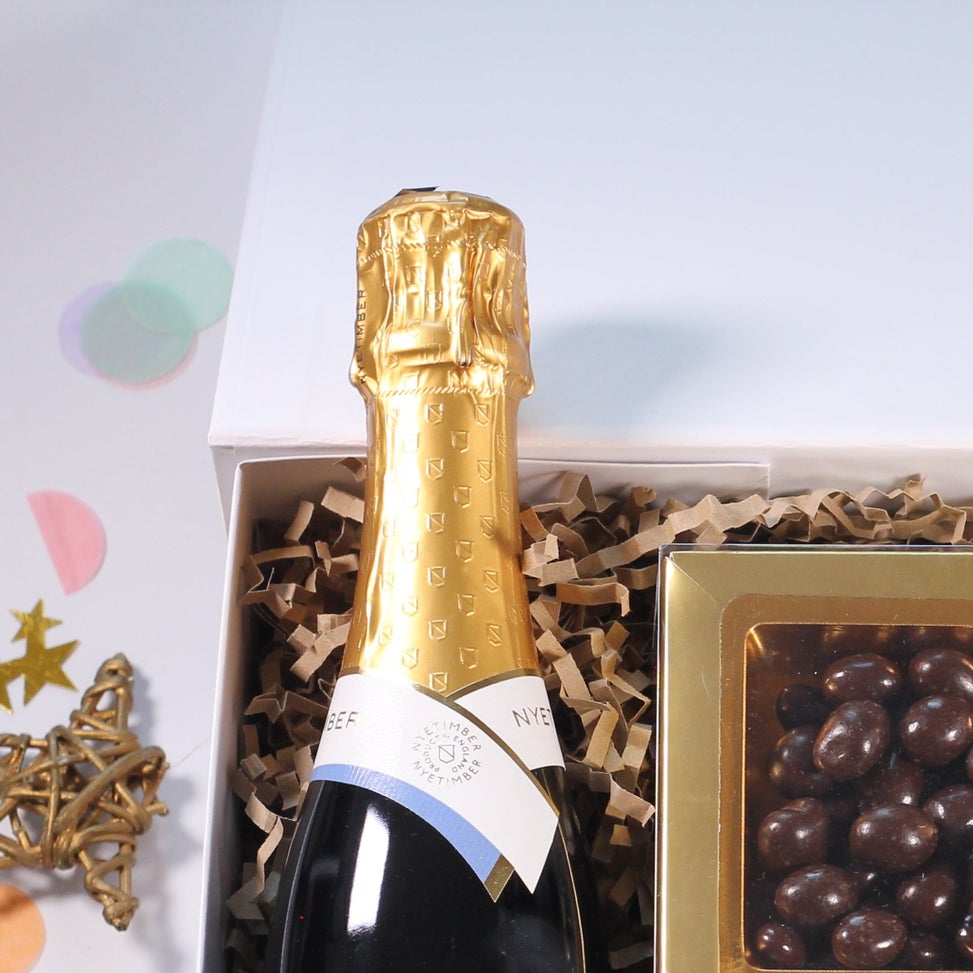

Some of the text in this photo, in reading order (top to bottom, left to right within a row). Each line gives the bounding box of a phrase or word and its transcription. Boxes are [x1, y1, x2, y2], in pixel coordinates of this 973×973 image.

[411, 721, 482, 752] NYETIMBER
[452, 736, 470, 773] ENGLAND
[413, 759, 482, 787] NYETIMBER
